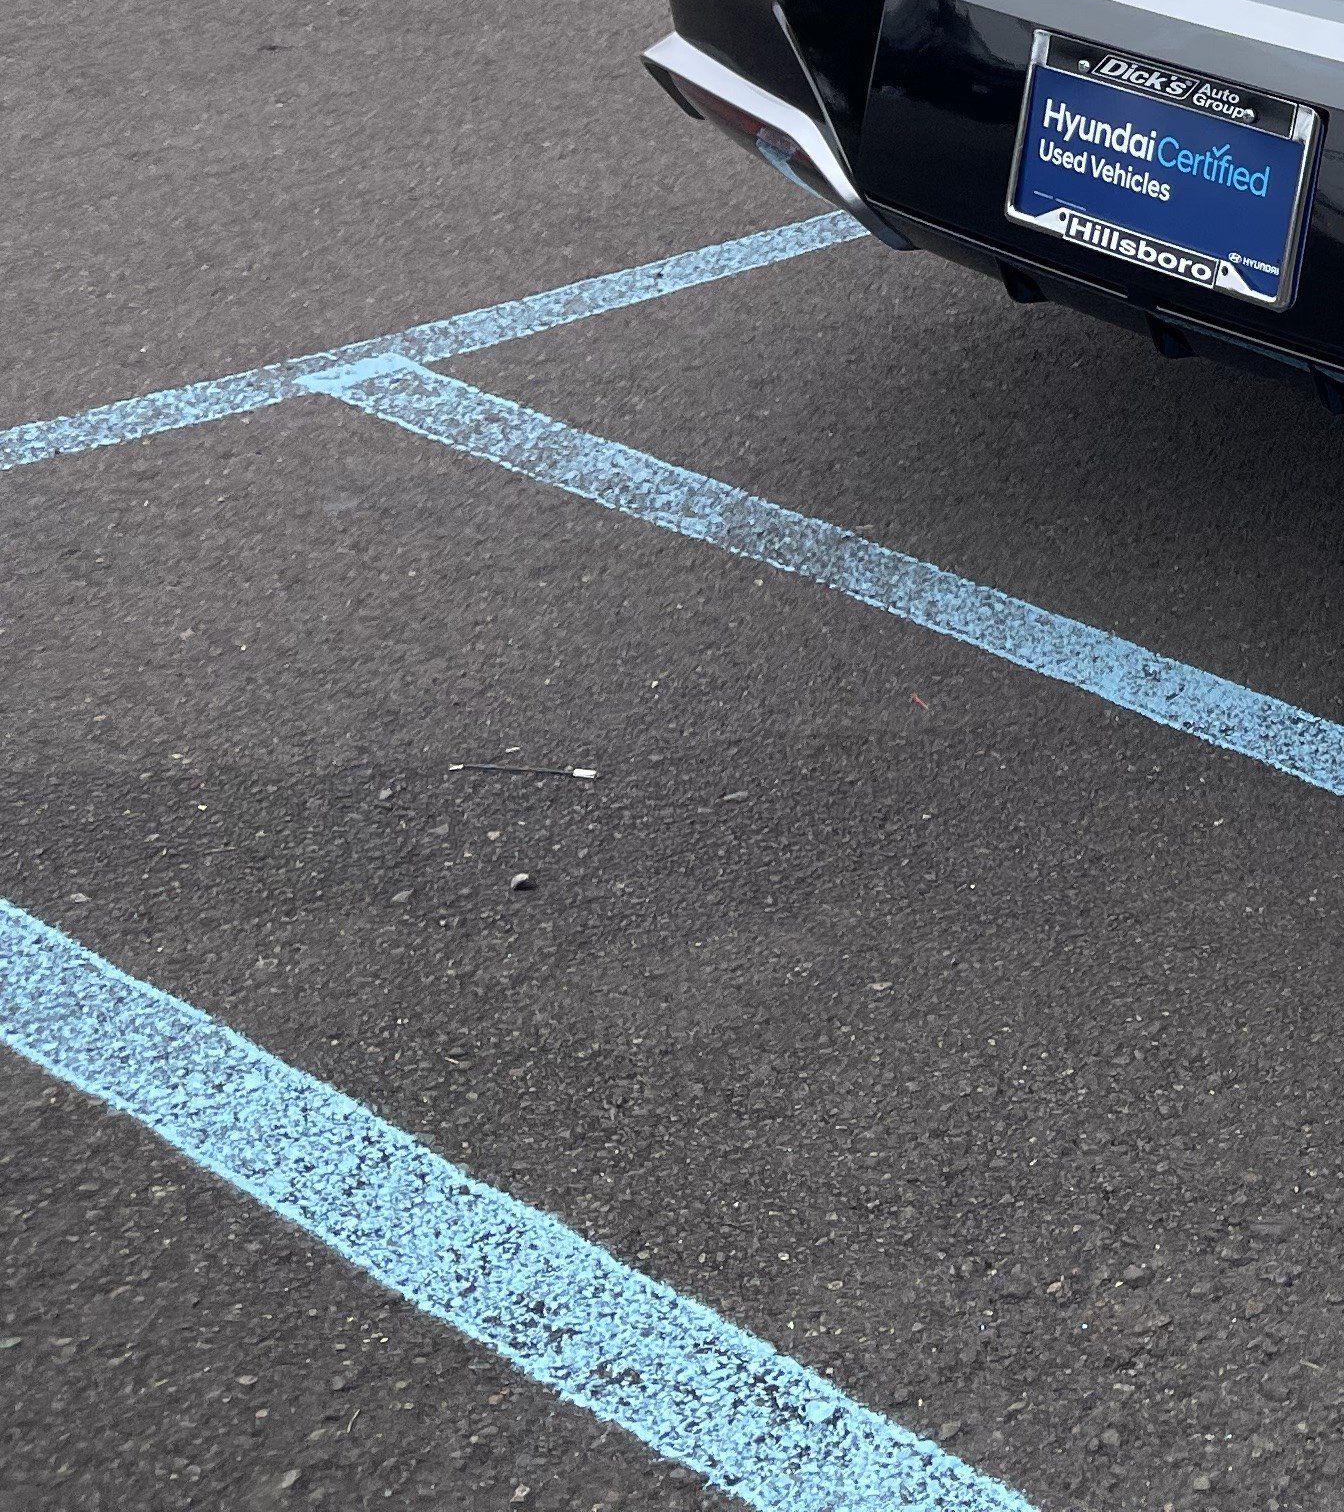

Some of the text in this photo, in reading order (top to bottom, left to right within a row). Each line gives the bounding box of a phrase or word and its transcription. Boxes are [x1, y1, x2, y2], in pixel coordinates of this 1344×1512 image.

[1100, 58, 1187, 95] Dick's
[1197, 83, 1240, 104] Auto
[1192, 93, 1245, 119] Group
[1039, 138, 1171, 201] Used Vehicles
[1157, 136, 1271, 197] Certified
[1069, 217, 1212, 281] Hillsboro
[1242, 256, 1280, 276] HYUNDAI
